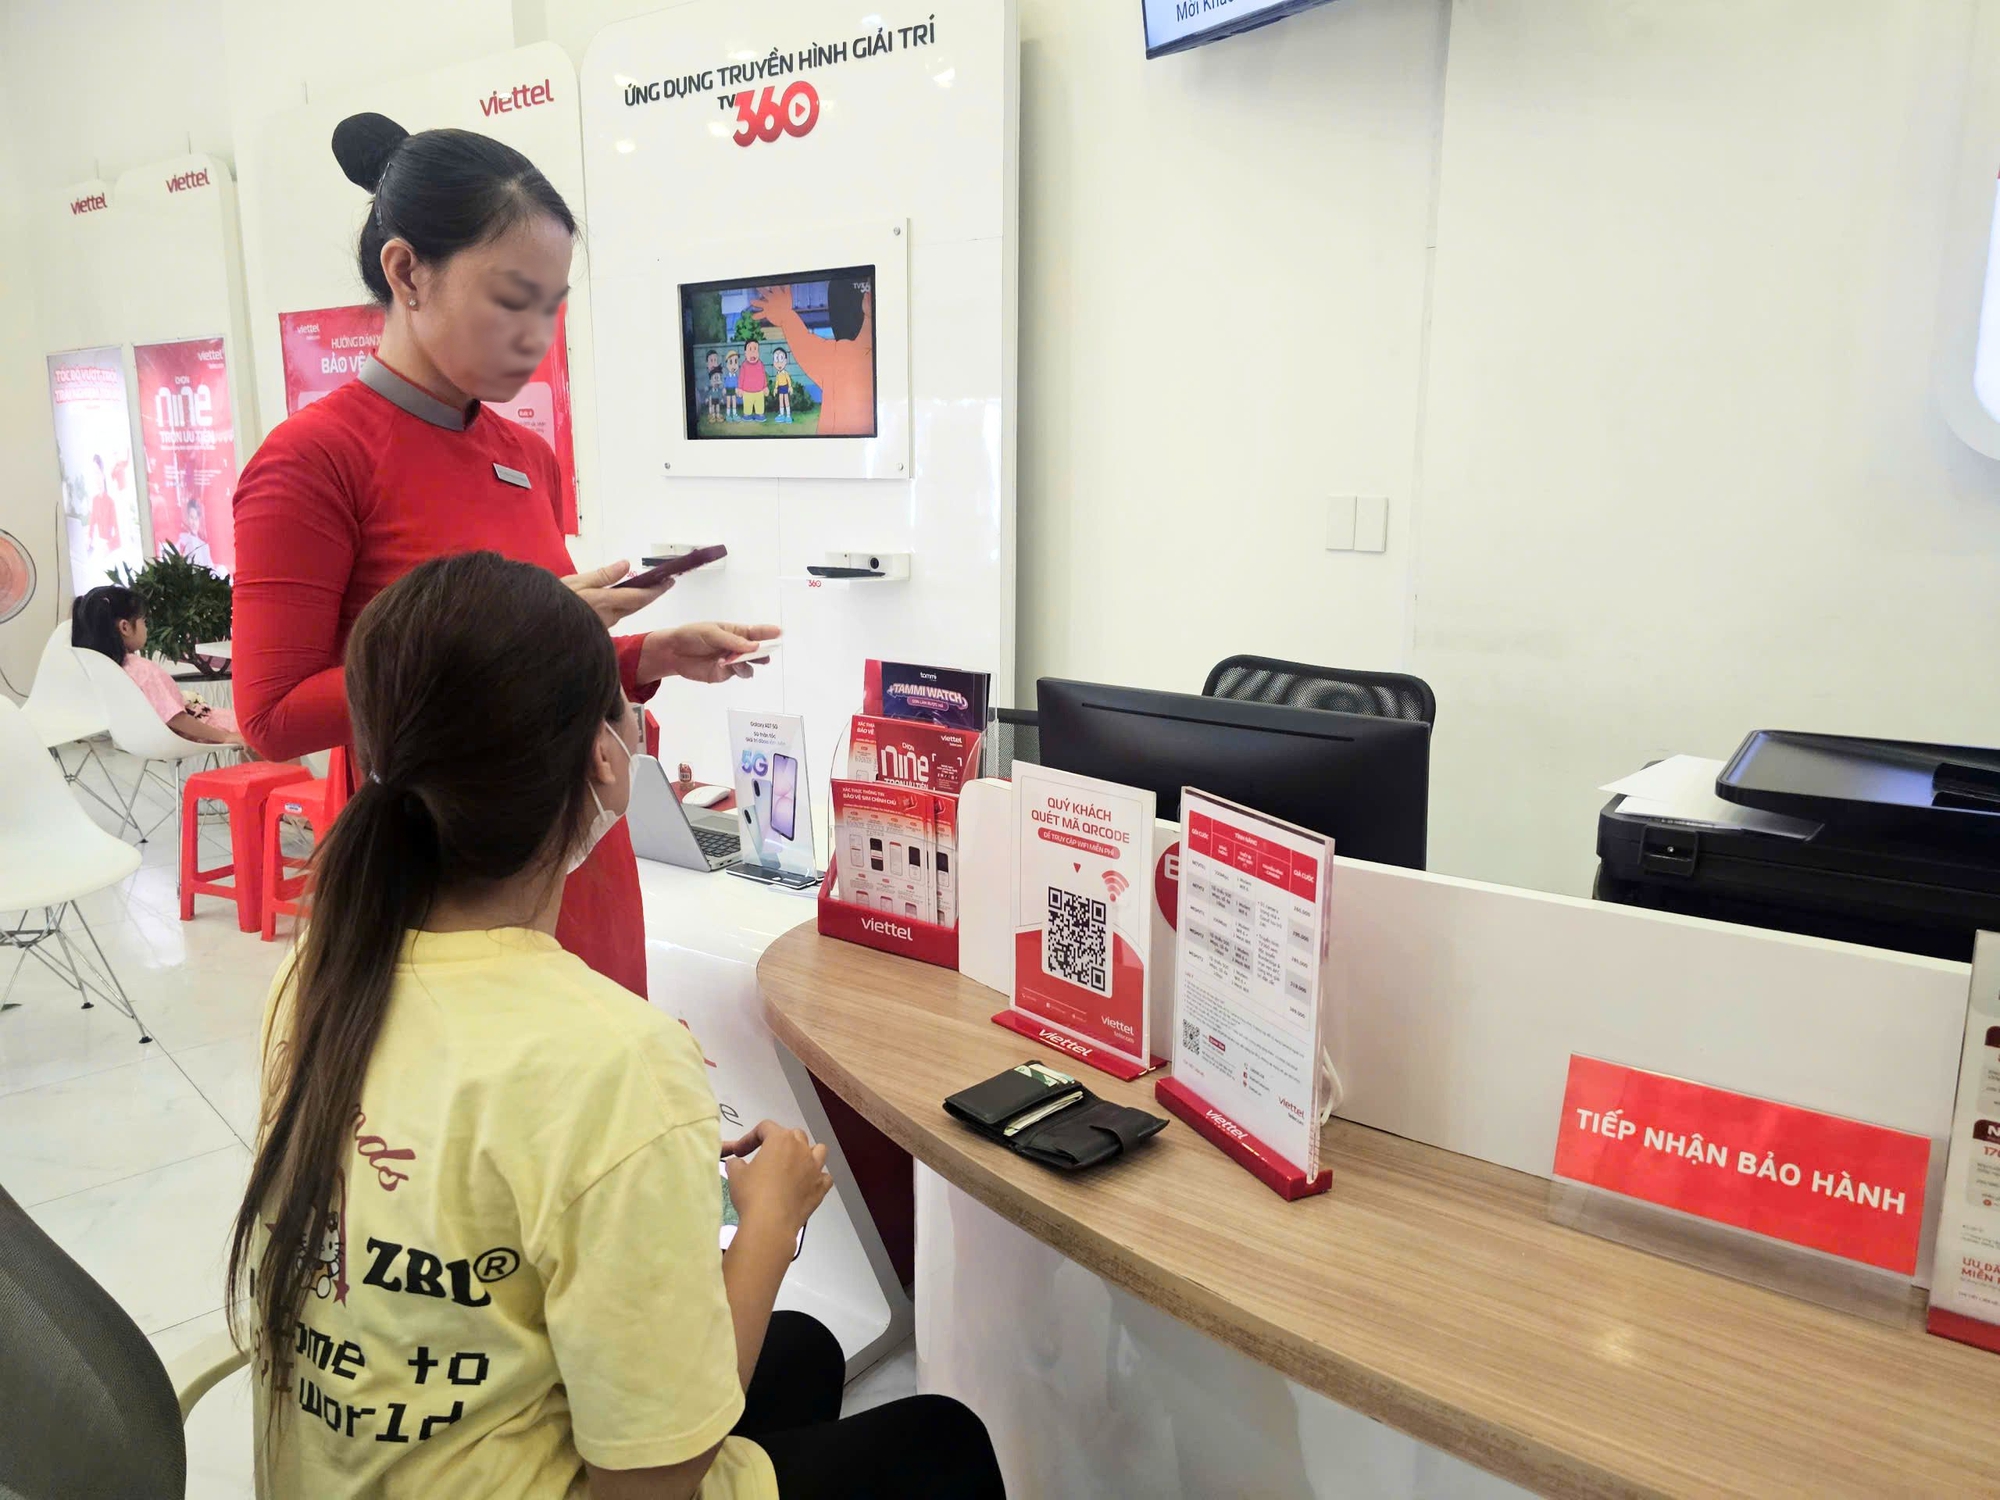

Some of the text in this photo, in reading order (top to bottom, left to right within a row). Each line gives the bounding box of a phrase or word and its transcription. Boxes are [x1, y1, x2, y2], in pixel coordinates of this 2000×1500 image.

[624, 13, 935, 107] ỨNG DỤNG TRUYỀN HÌNH GIẢI TRÍ
[479, 78, 554, 117] viettel
[165, 168, 210, 193] viettel
[70, 192, 108, 215] viettel
[297, 323, 320, 334] viettel
[197, 350, 223, 361] viettel
[321, 351, 347, 374] BẢO
[155, 384, 213, 427] nine
[926, 687, 961, 703] WATCH
[941, 735, 962, 743] viettel
[741, 749, 768, 777] 5G
[881, 745, 929, 782] nine
[1047, 797, 1112, 822] QUÝ KHÁCH
[1031, 809, 1130, 844] QUÉT MÃ QRCODE
[1051, 832, 1066, 843] TRUY
[861, 917, 913, 941] viettel
[1101, 1015, 1134, 1036] viettel
[1038, 1029, 1093, 1057] viettel
[1278, 1097, 1305, 1119] viettel
[1205, 1109, 1249, 1140] viettel
[1576, 1108, 1906, 1215] TIẾP NHẬN BẢO HÀNH
[407, 1346, 489, 1386] to
